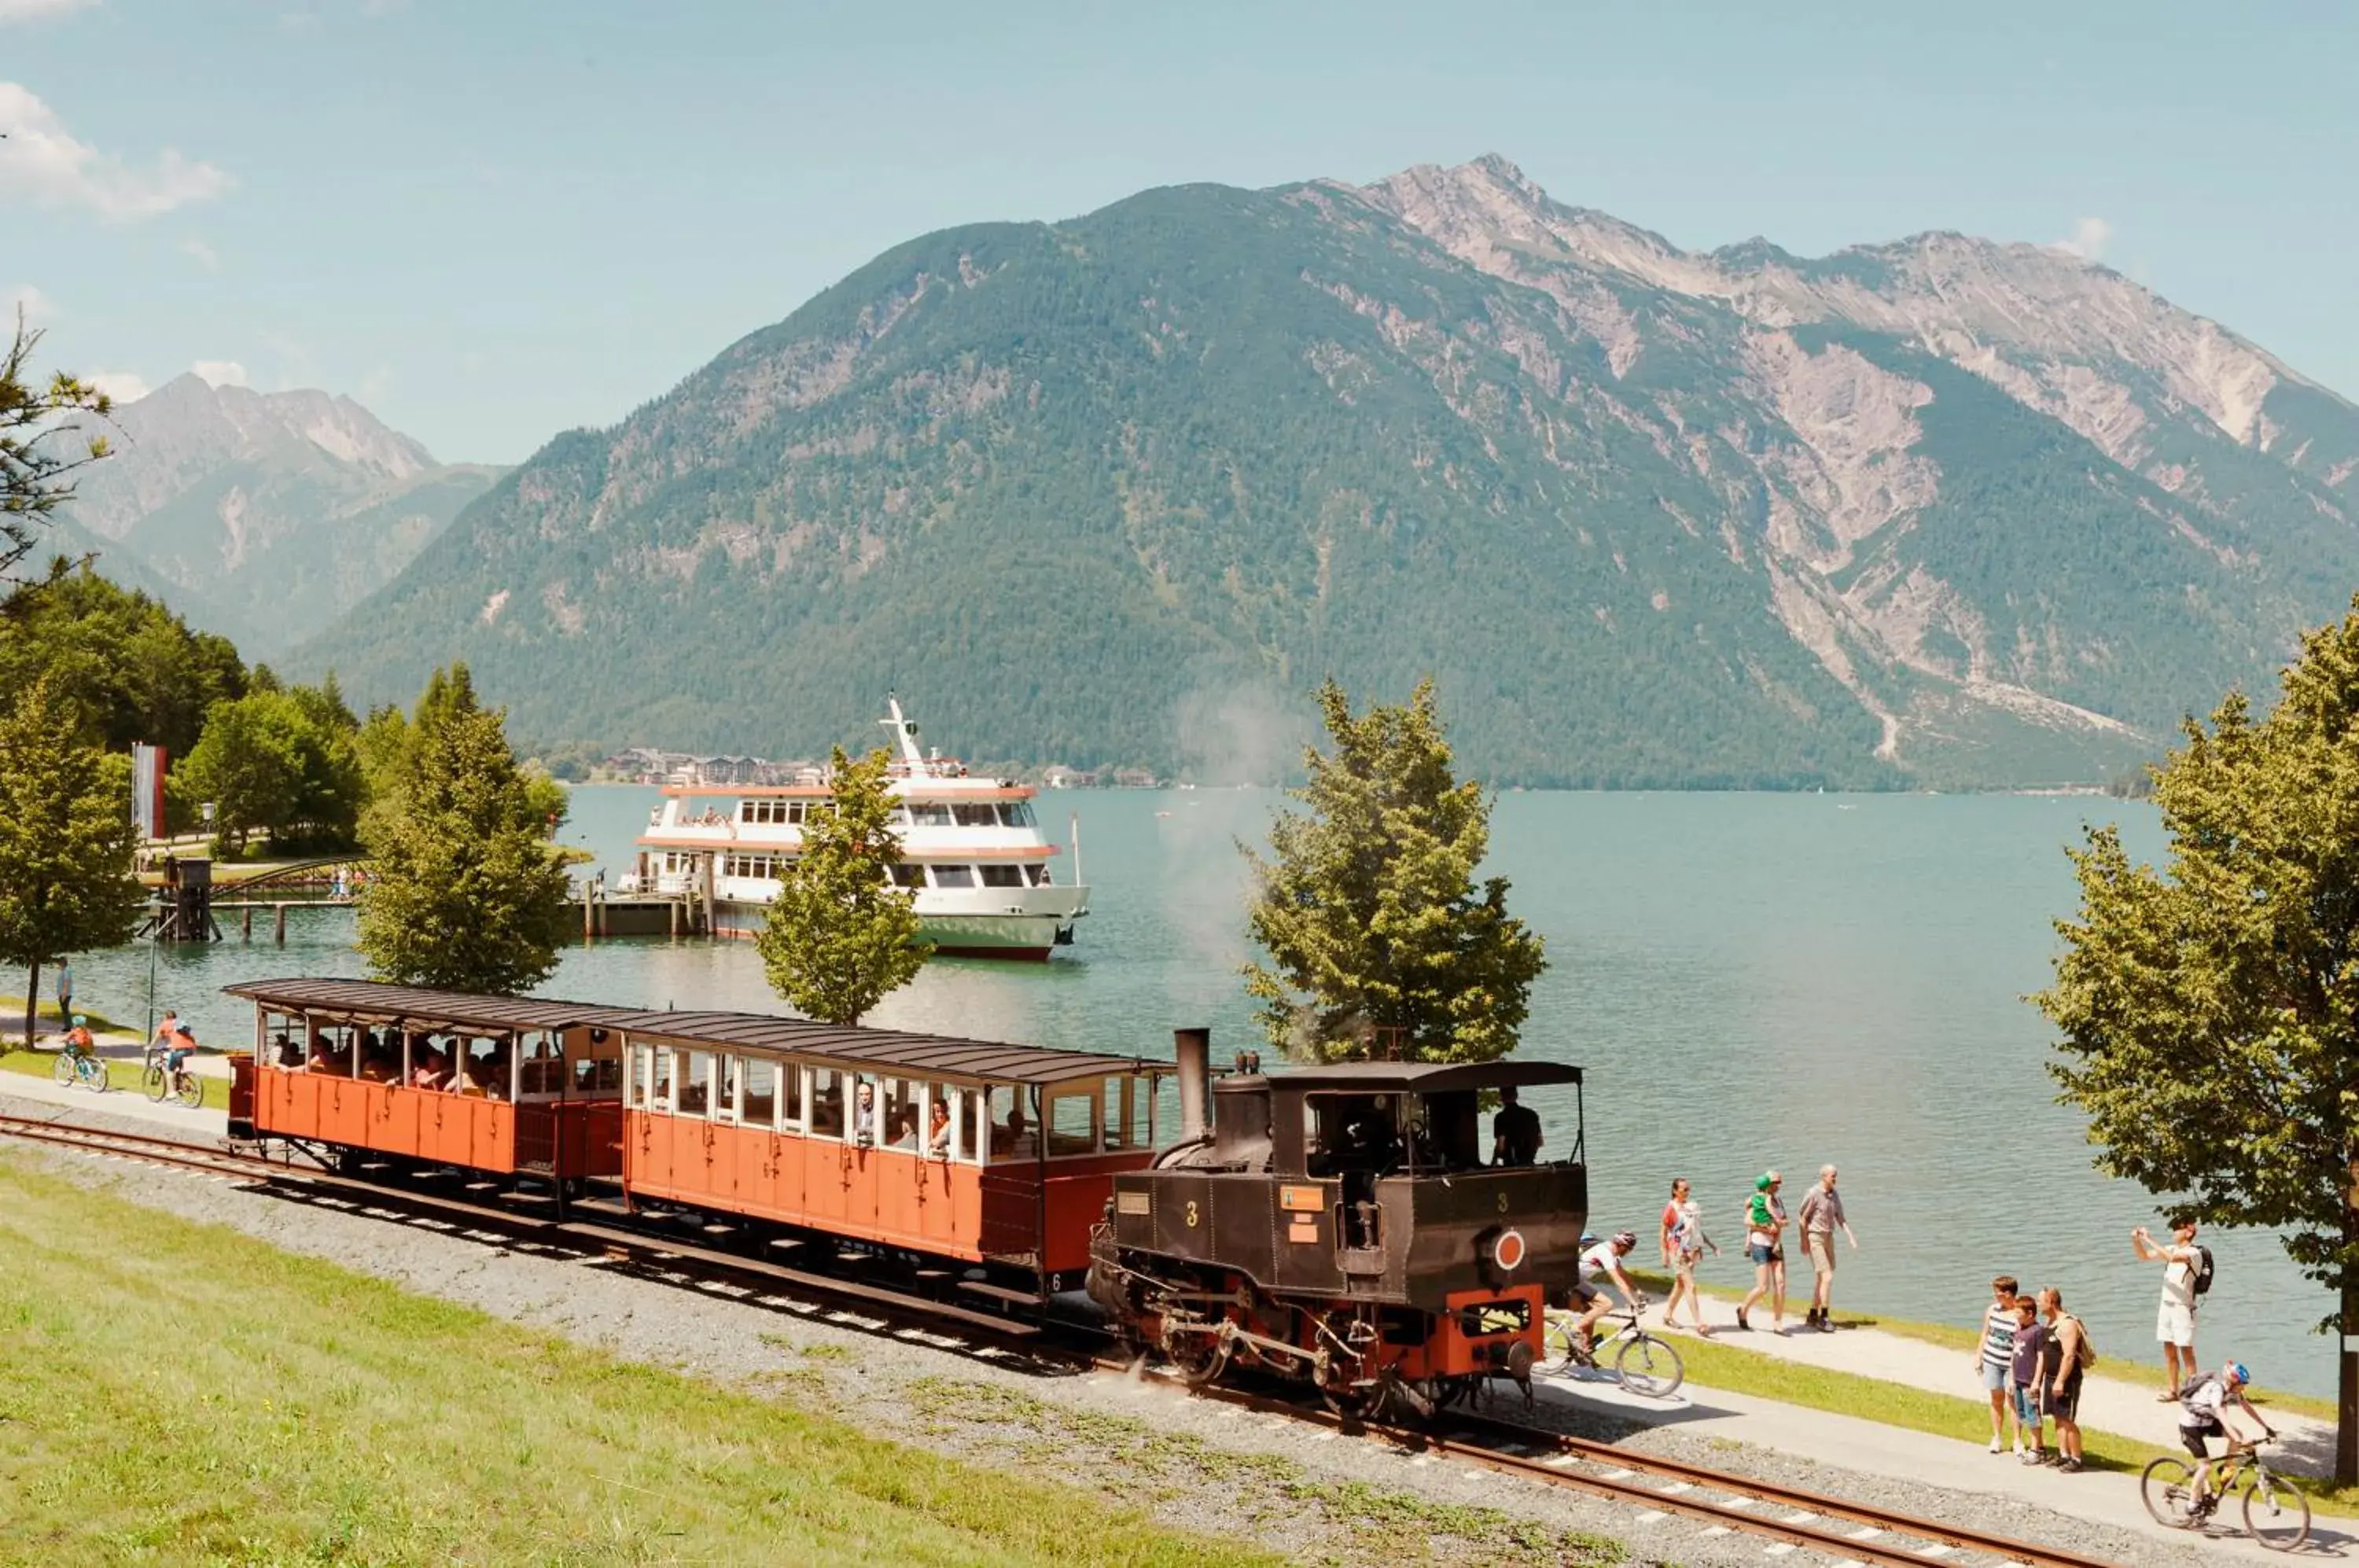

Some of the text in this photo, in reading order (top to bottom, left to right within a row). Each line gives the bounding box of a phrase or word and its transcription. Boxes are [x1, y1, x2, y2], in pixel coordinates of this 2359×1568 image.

[1498, 1192, 1508, 1213] 3
[1187, 1201, 1198, 1227] 3
[1053, 1273, 1061, 1291] 6
